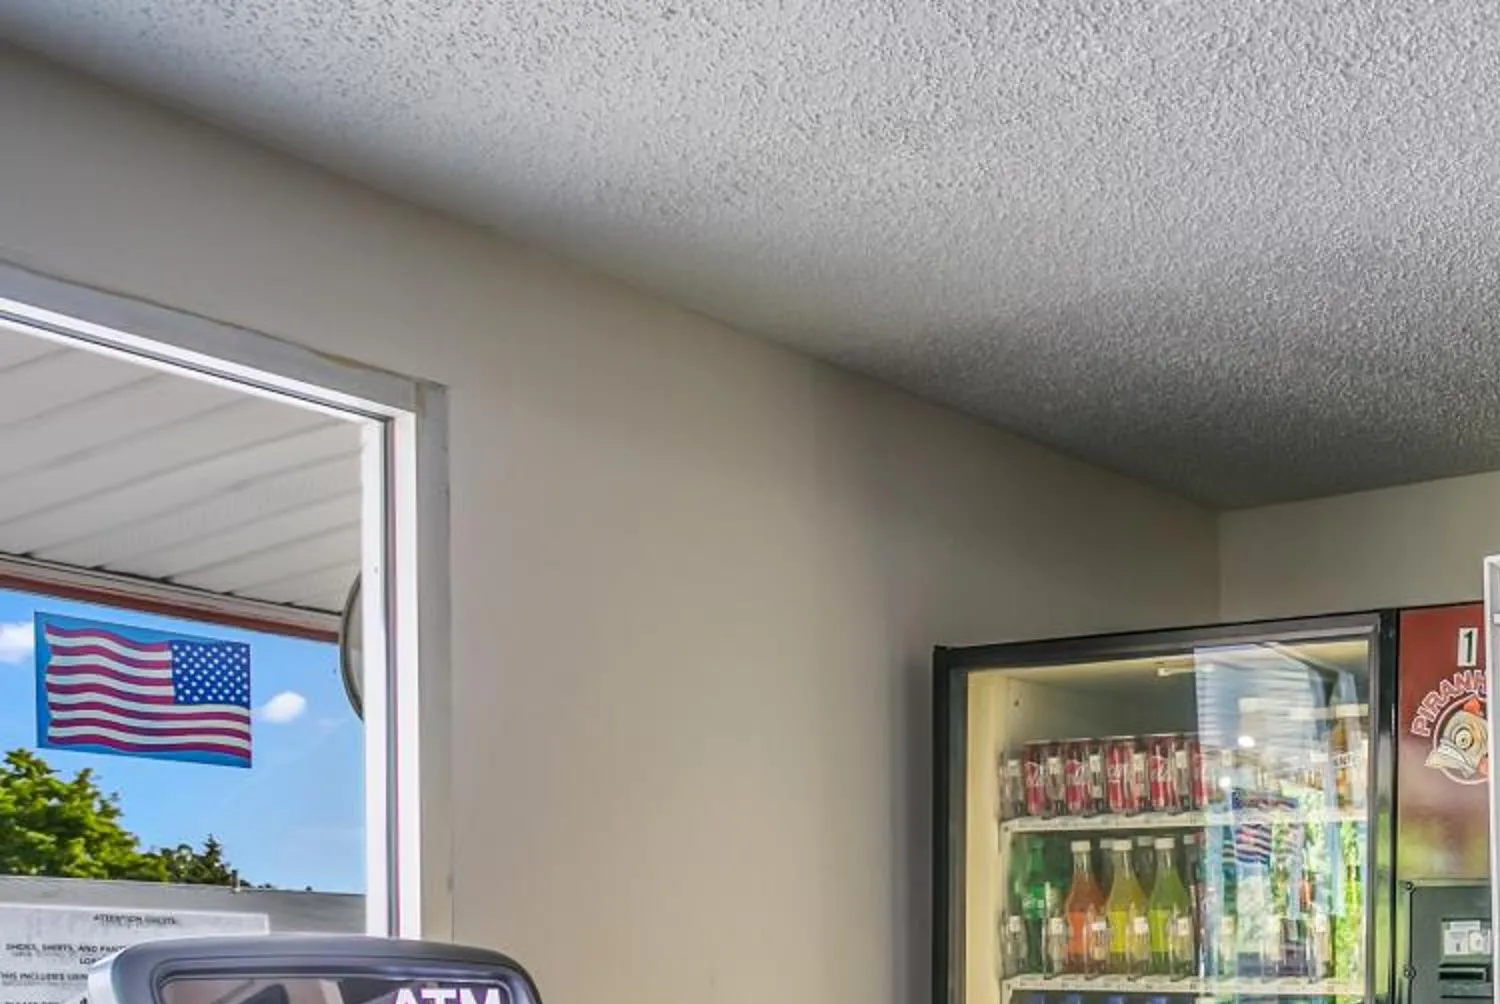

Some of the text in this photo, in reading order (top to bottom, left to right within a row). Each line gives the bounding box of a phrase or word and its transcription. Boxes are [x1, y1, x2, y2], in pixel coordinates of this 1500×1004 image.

[1463, 629, 1475, 665] 1
[1410, 669, 1488, 738] PIRANH
[100, 945, 127, 953] PANT
